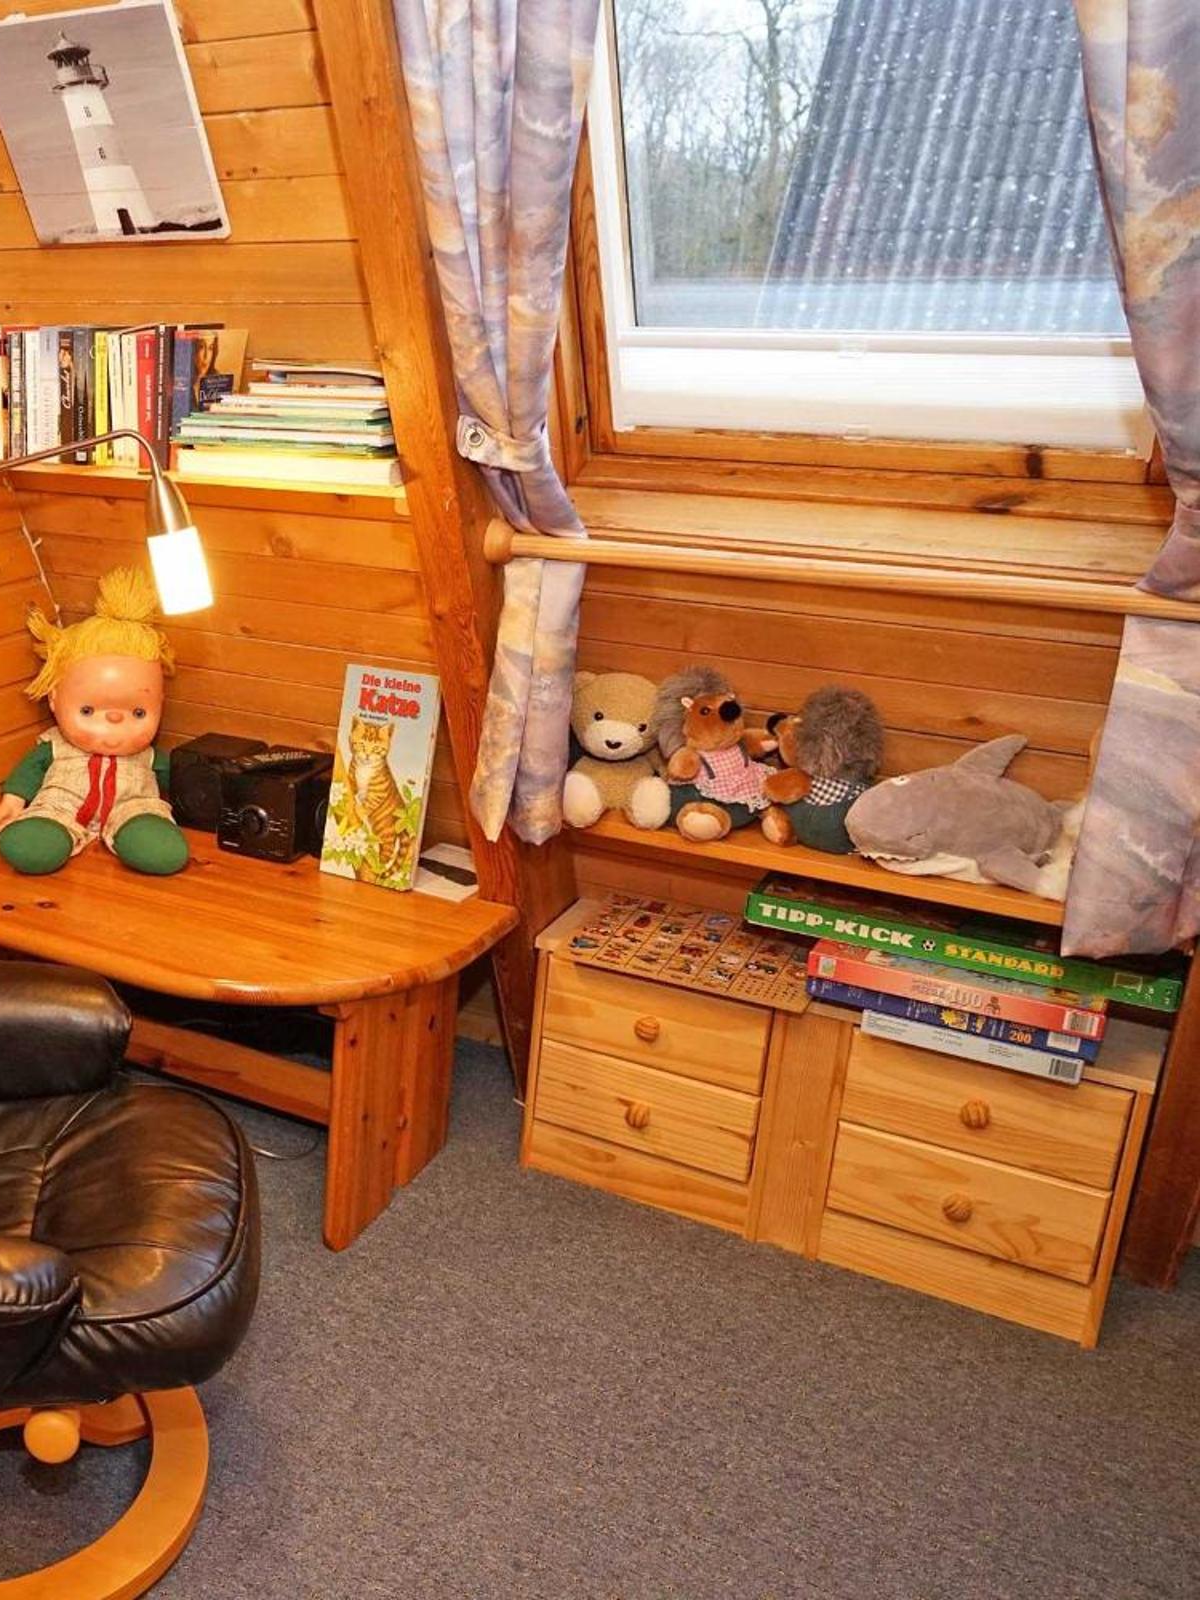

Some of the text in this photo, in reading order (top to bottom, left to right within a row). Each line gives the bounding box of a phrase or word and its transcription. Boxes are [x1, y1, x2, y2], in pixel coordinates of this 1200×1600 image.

[362, 673, 421, 693] Die kleine
[359, 687, 421, 719] Katze
[758, 902, 1065, 978] TIPP-KICK STANDARD
